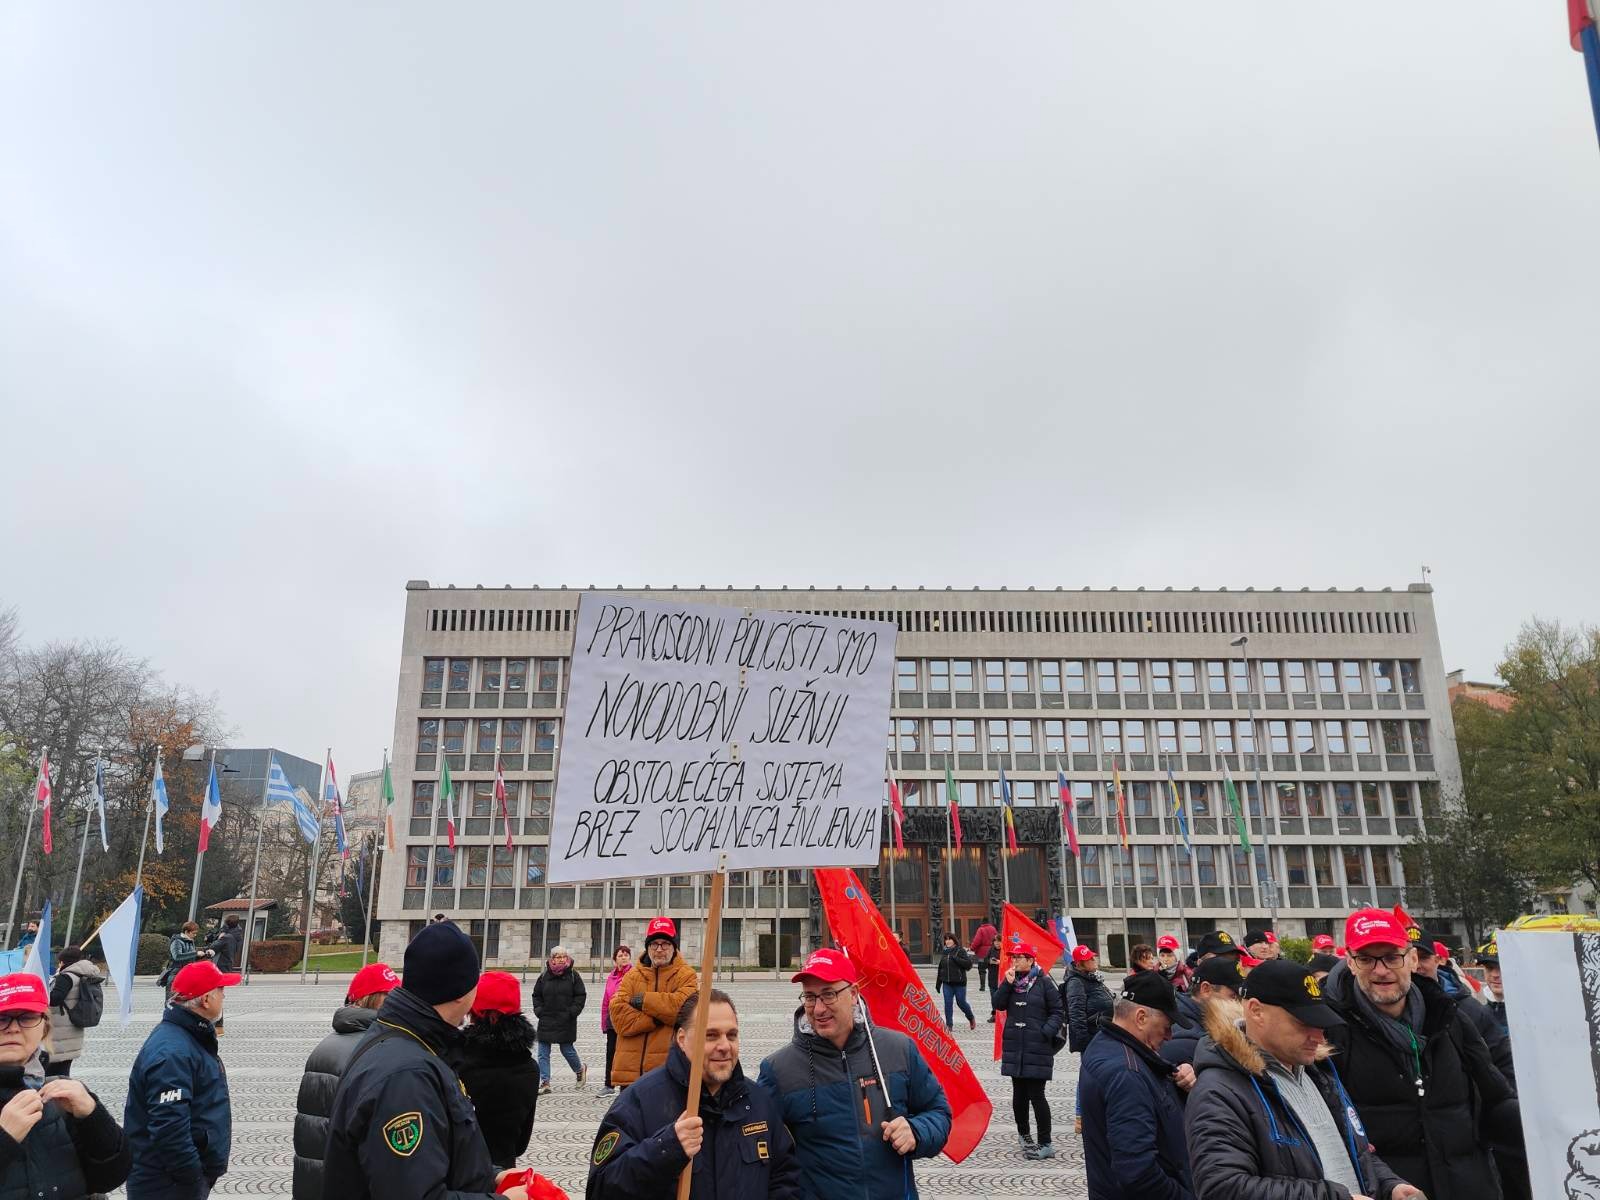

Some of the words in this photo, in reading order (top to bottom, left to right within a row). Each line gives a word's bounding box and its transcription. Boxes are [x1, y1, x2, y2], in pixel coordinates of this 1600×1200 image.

[586, 604, 726, 666] PRAVOSODNI
[724, 616, 828, 672] POLICISTI
[823, 627, 878, 678] SMO
[585, 672, 749, 744] NOVODOBNI
[749, 677, 849, 749] SUŽNJI
[594, 749, 746, 805] OBSTOJEČEGA
[756, 761, 844, 801] SISTEMA
[564, 809, 641, 860] BREZ
[650, 804, 780, 855] SOCIALNEGA
[898, 1003, 966, 1074] LOVENIJE
[159, 1088, 182, 1104] HH
